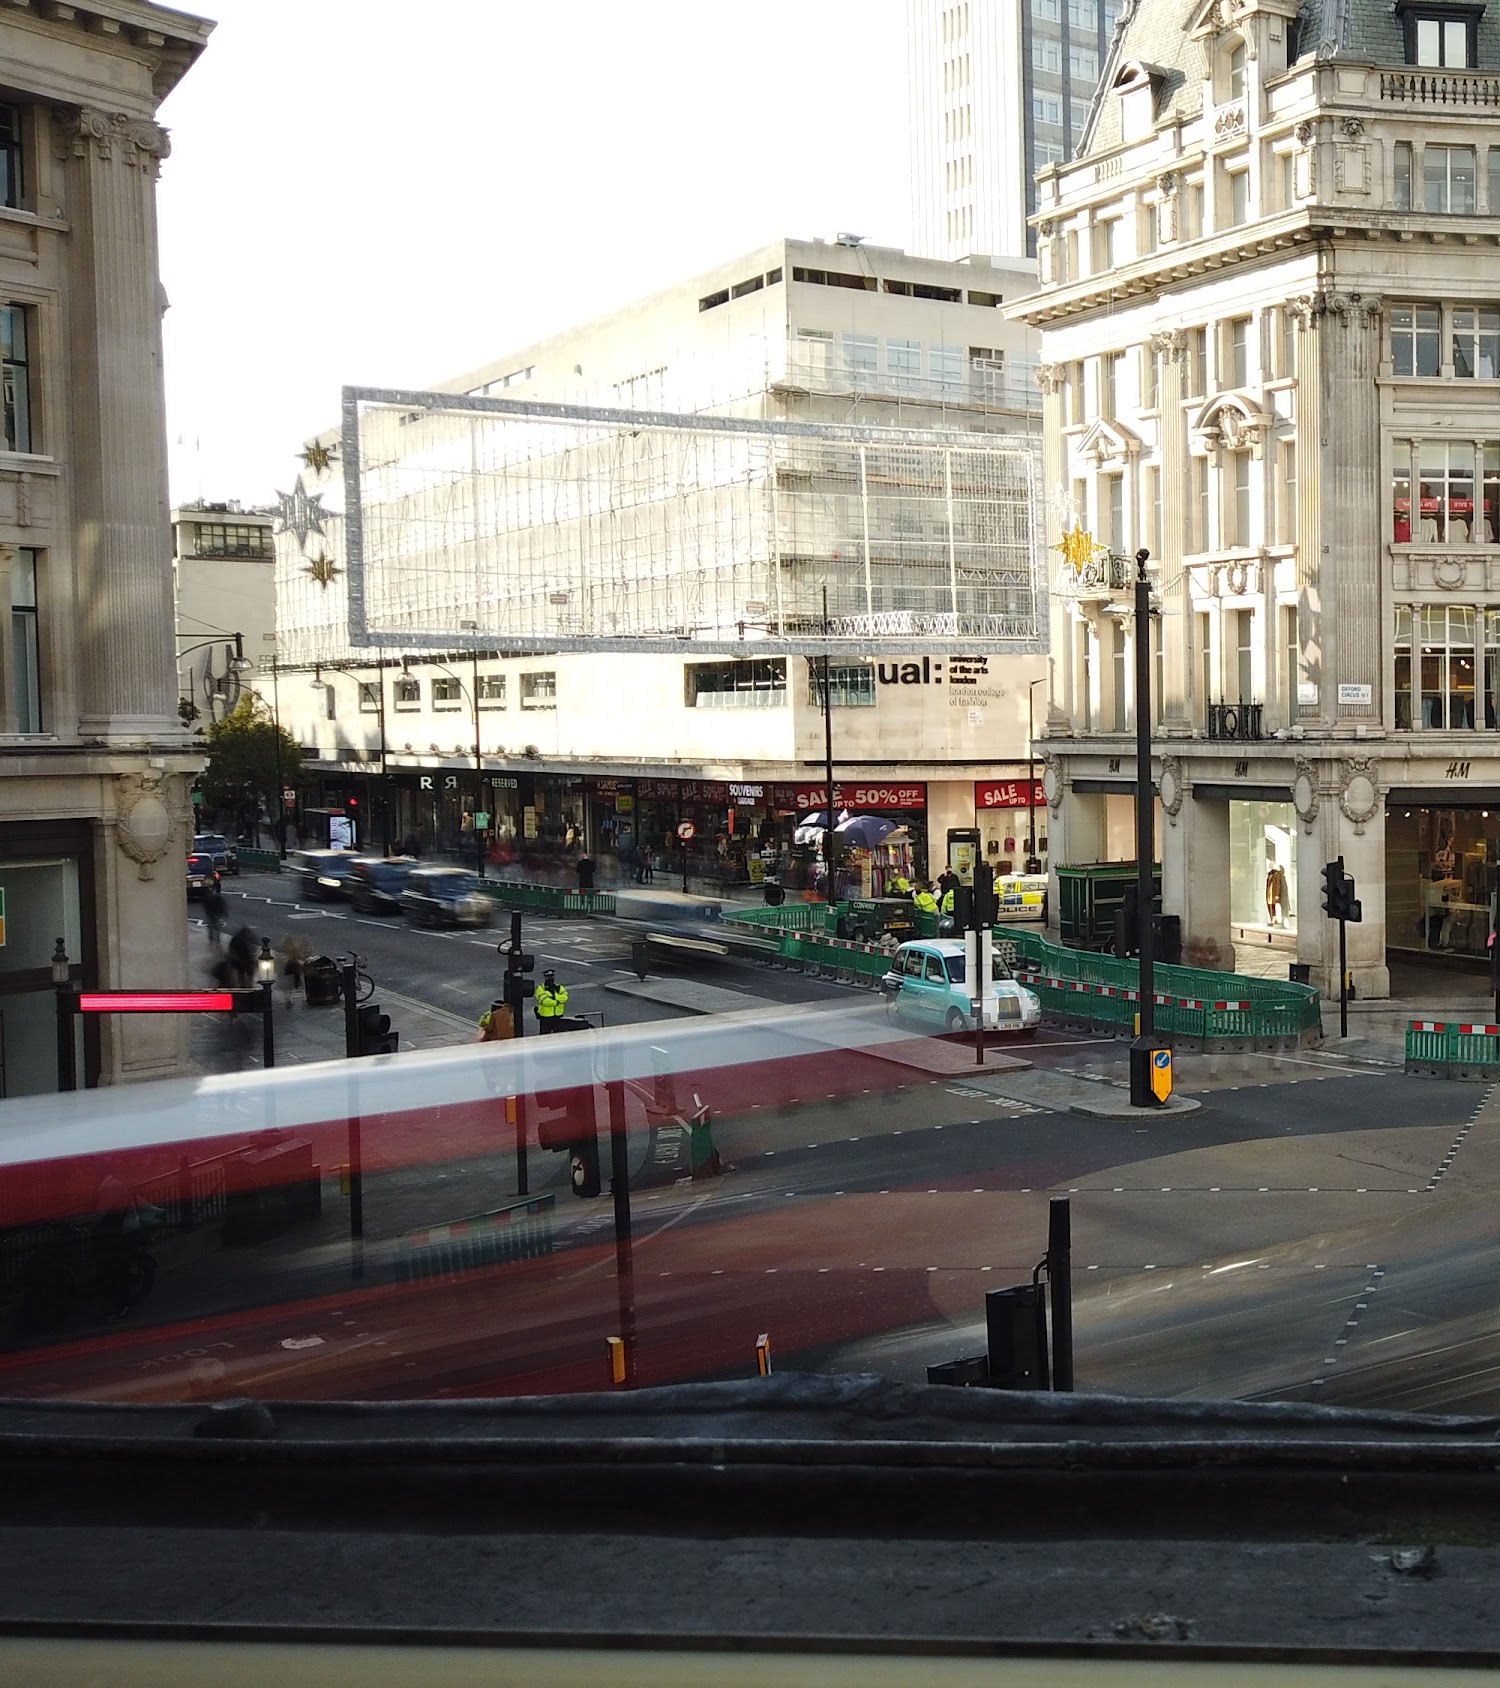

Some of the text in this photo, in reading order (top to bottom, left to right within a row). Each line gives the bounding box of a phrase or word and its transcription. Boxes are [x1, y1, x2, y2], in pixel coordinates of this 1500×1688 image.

[949, 656, 988, 665] university
[878, 656, 942, 684] ual:
[949, 665, 957, 674] of
[959, 665, 972, 674] the
[950, 676, 977, 684] london
[949, 687, 976, 696] london
[1109, 758, 1120, 773] H&M
[1234, 761, 1249, 777] H&M
[1445, 761, 1471, 779] H&M
[491, 777, 518, 788] RESERVED
[729, 784, 764, 797] SOUVENIRS
[984, 783, 1017, 806] SALE
[1009, 797, 1017, 805] UP
[1018, 796, 1026, 804] TO
[797, 790, 842, 808] SALE
[855, 789, 898, 804] 50%
[898, 789, 919, 798] OFF
